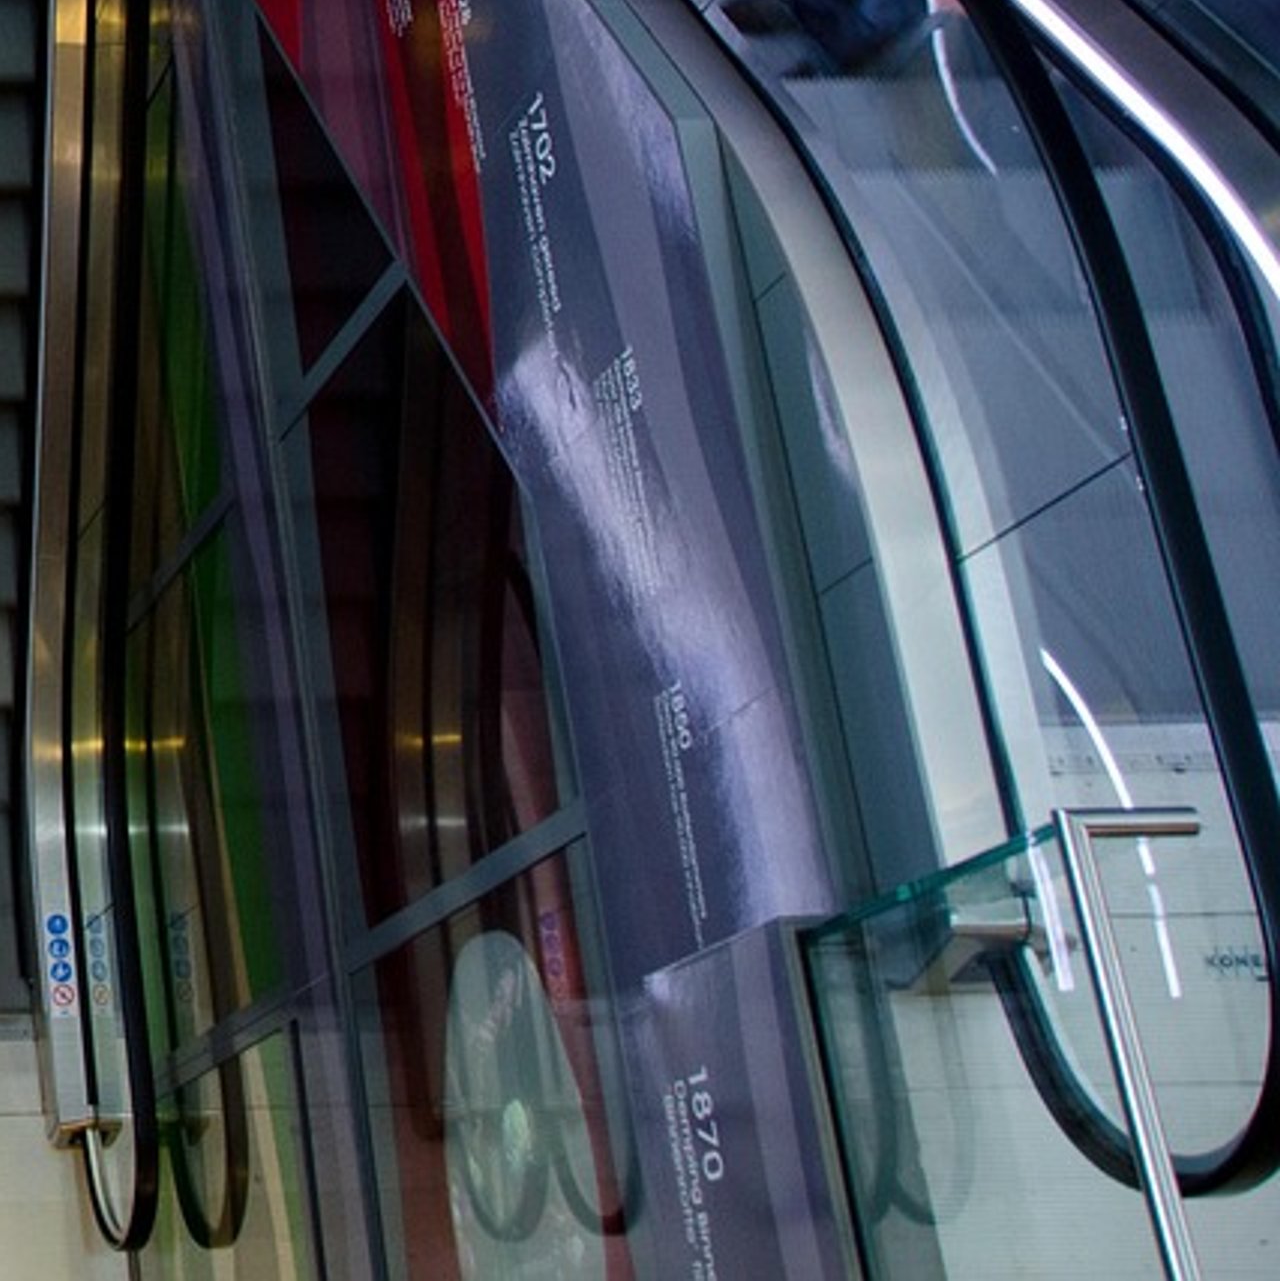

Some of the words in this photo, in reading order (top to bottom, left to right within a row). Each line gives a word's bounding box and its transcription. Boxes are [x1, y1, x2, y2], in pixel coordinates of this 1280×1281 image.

[528, 91, 556, 185] 1702
[1204, 954, 1262, 969] KONE
[674, 1080, 703, 1205] Demping
[688, 1065, 724, 1181] 1870
